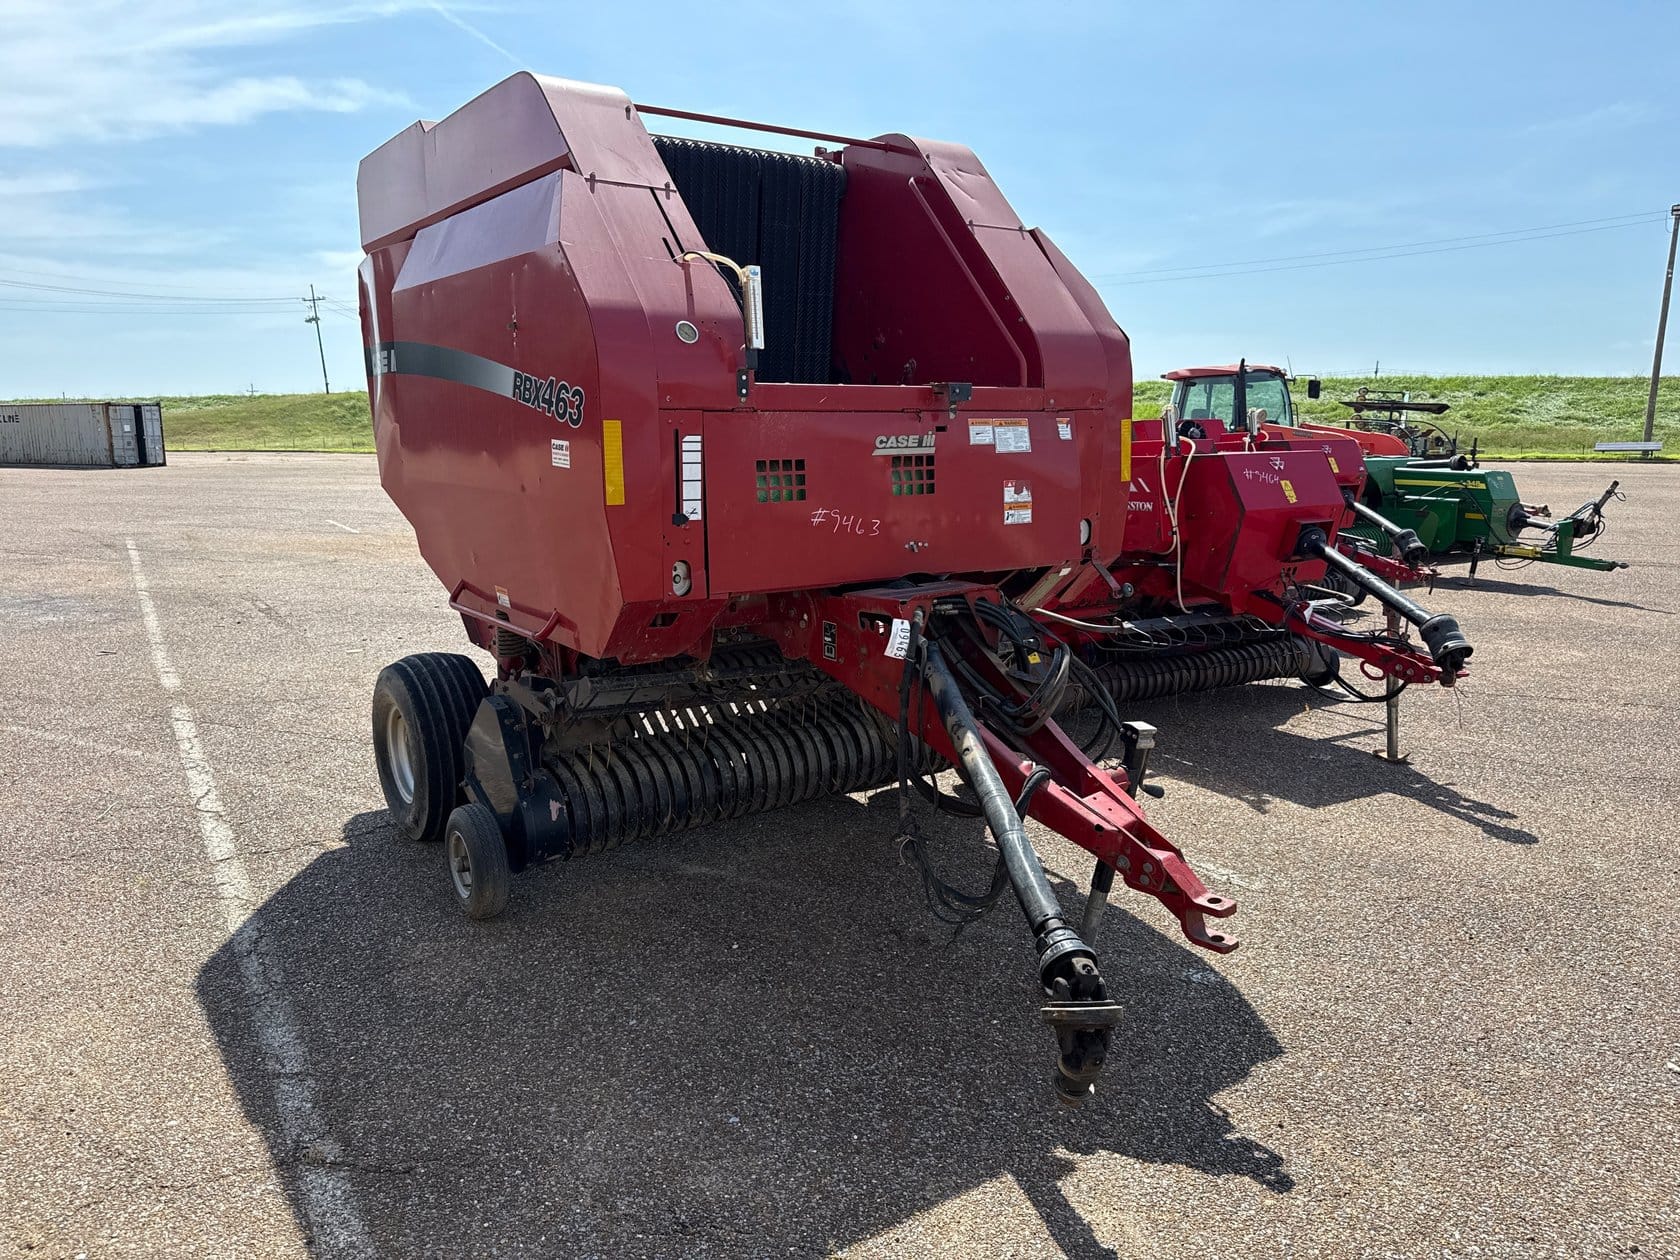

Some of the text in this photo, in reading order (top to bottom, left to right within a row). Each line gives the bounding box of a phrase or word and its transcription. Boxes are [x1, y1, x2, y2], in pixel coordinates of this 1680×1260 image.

[512, 370, 585, 429] RBX463
[875, 435, 919, 449] CASE
[811, 507, 881, 536] #9463
[894, 628, 910, 658] 09463
